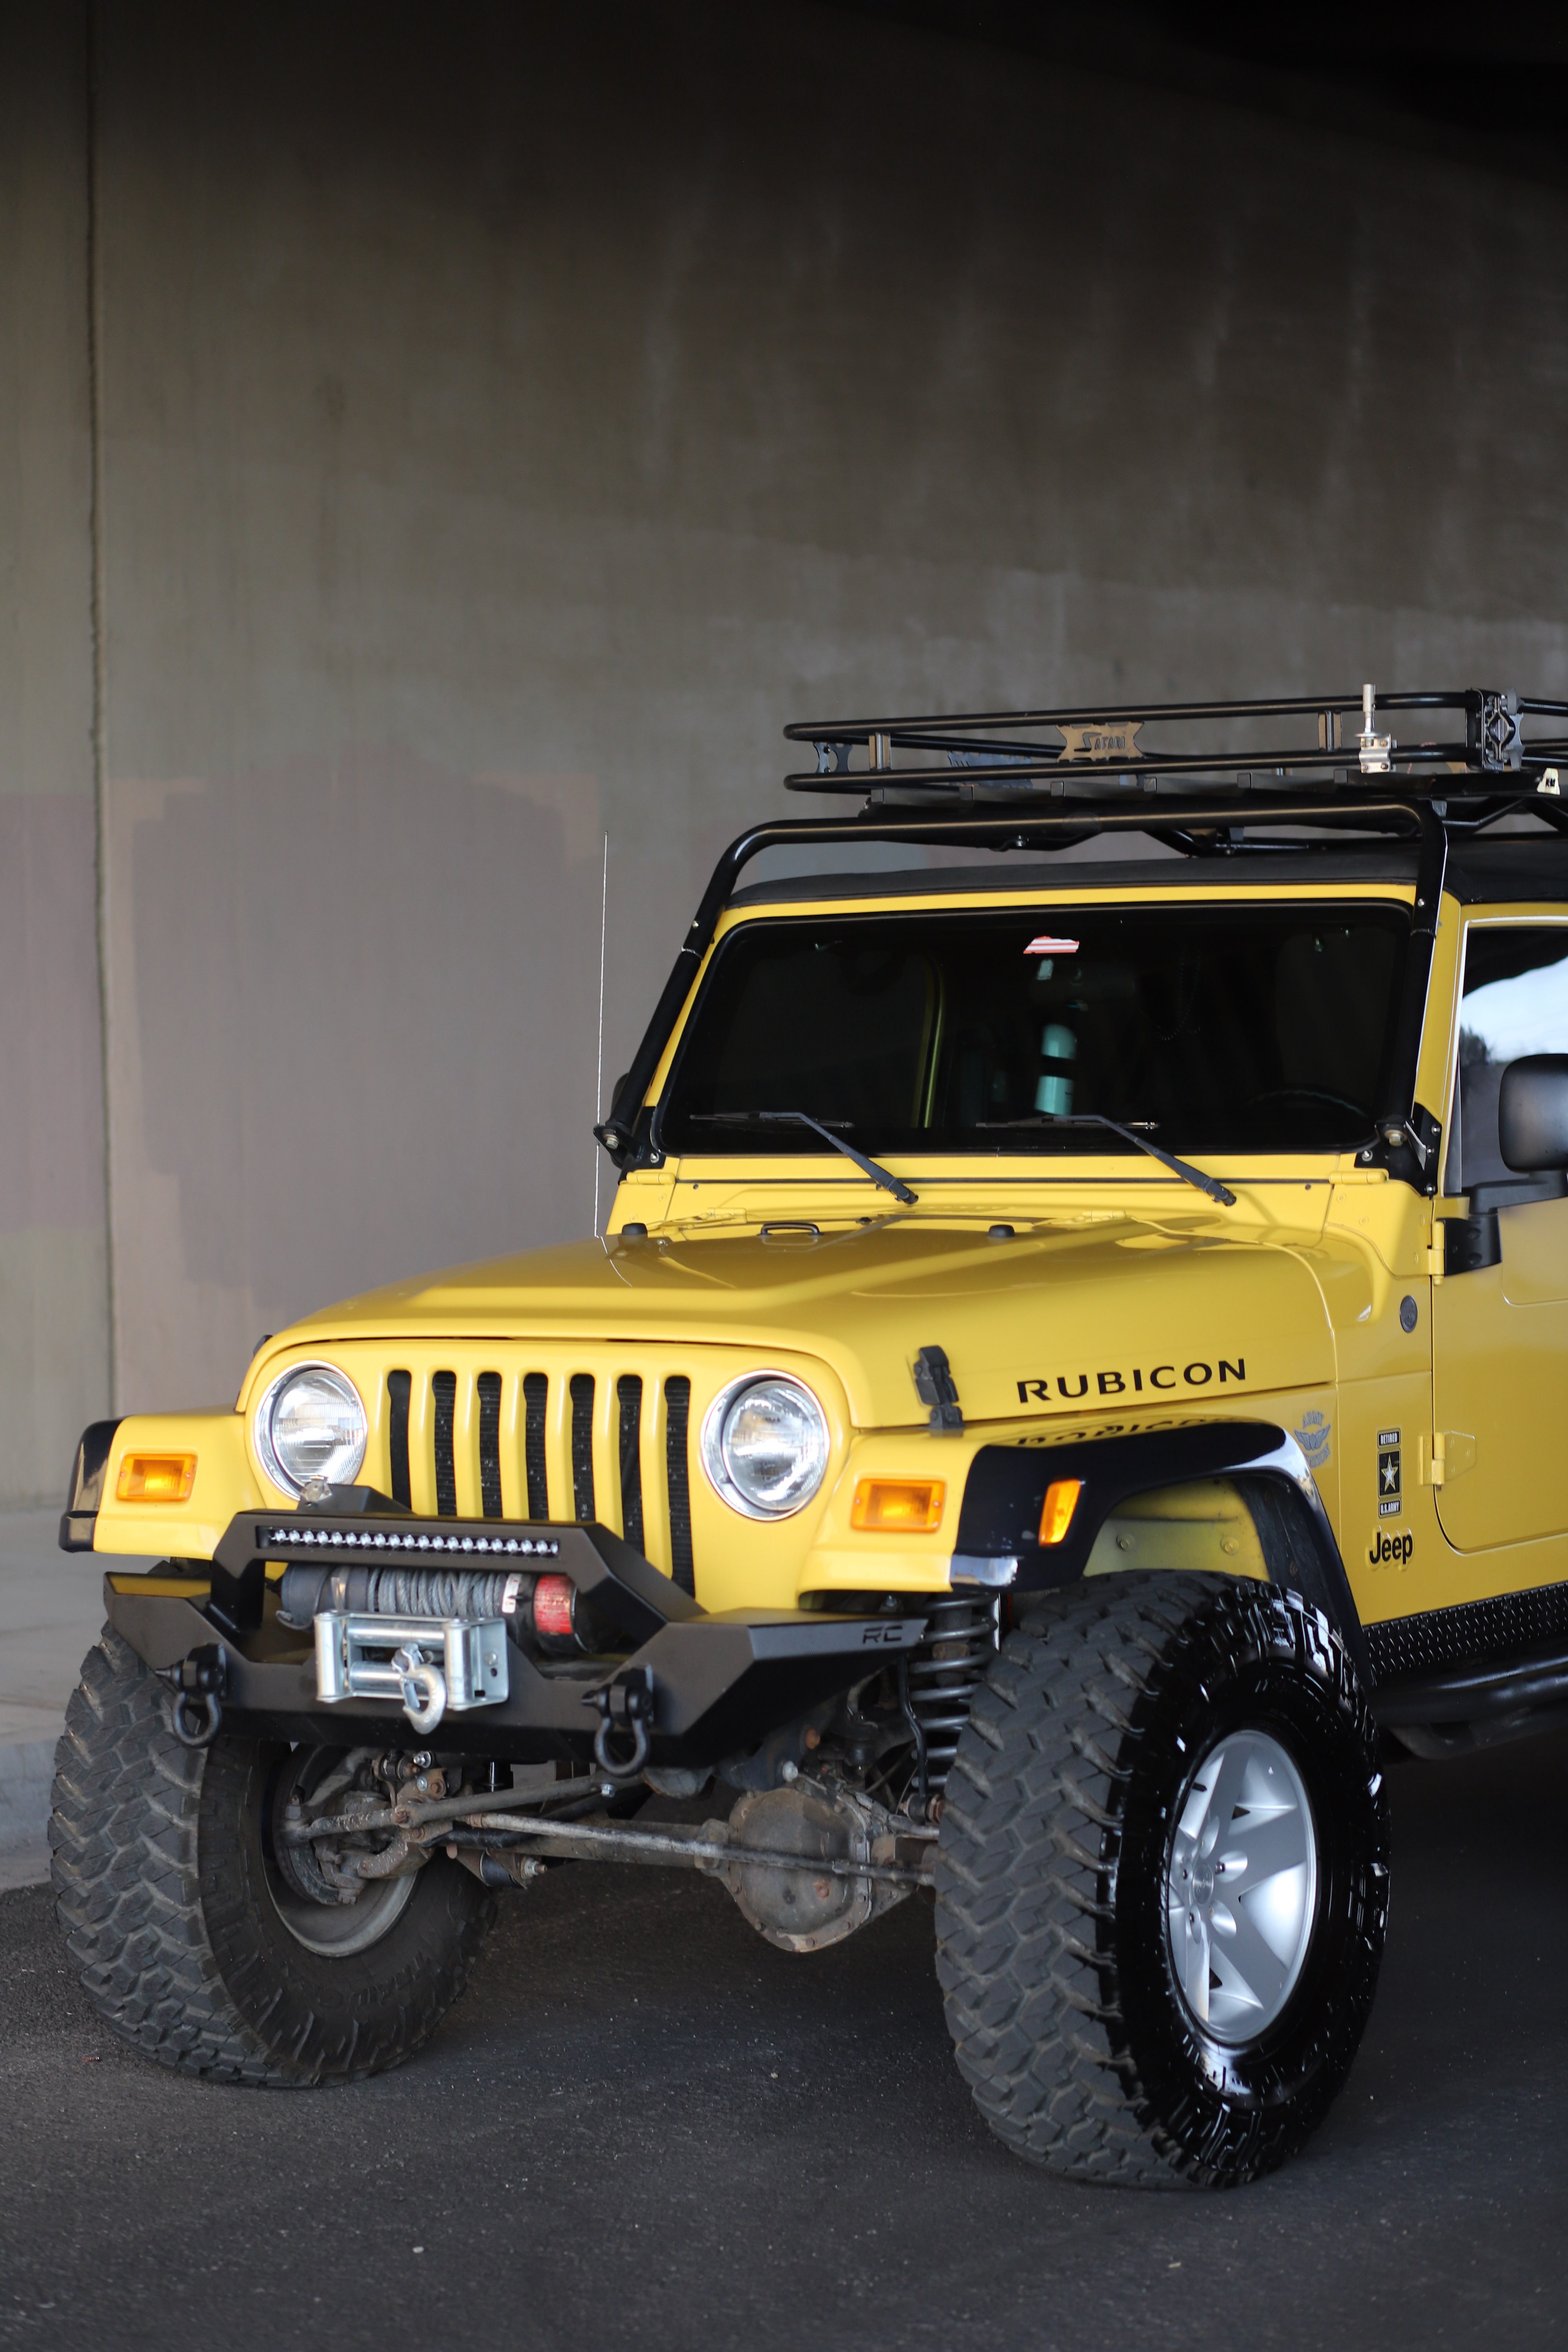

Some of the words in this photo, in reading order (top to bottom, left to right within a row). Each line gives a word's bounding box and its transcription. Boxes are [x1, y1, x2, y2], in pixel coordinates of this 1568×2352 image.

[1074, 732, 1125, 752] SAFARI
[1017, 1359, 1246, 1403] RUBICON
[1303, 1411, 1324, 1429] ARMY
[1380, 1432, 1397, 1445] RETIRED
[1369, 1532, 1413, 1564] Jeep
[863, 1625, 902, 1644] RC
